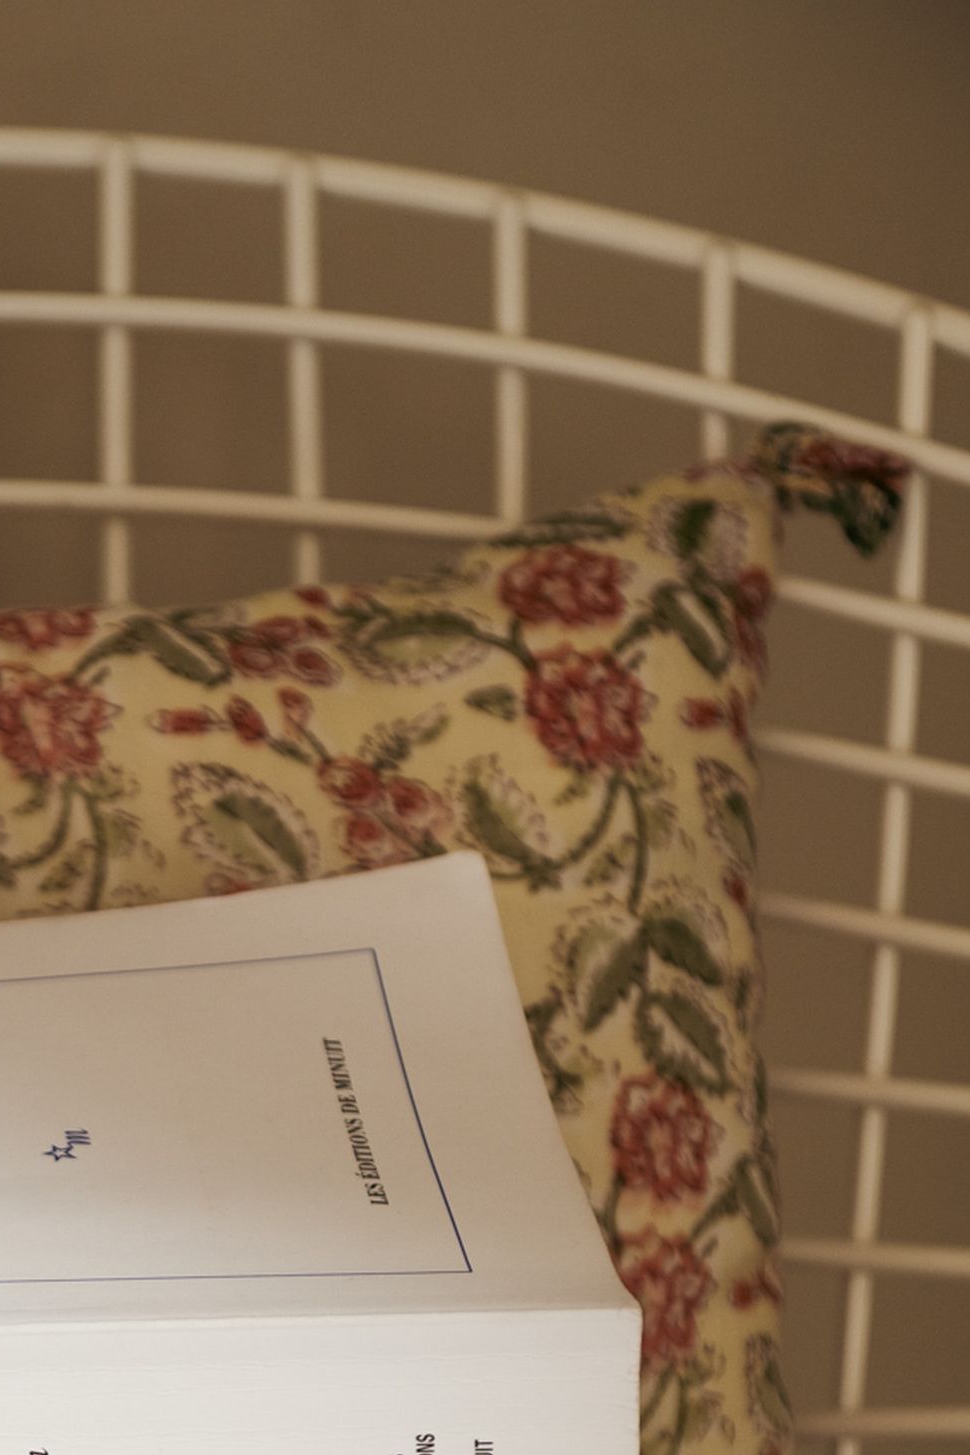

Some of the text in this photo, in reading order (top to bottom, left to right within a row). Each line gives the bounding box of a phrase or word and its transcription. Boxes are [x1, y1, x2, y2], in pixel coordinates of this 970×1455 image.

[321, 1036, 390, 1206] LES ÉDITIONS DE MINUIT
